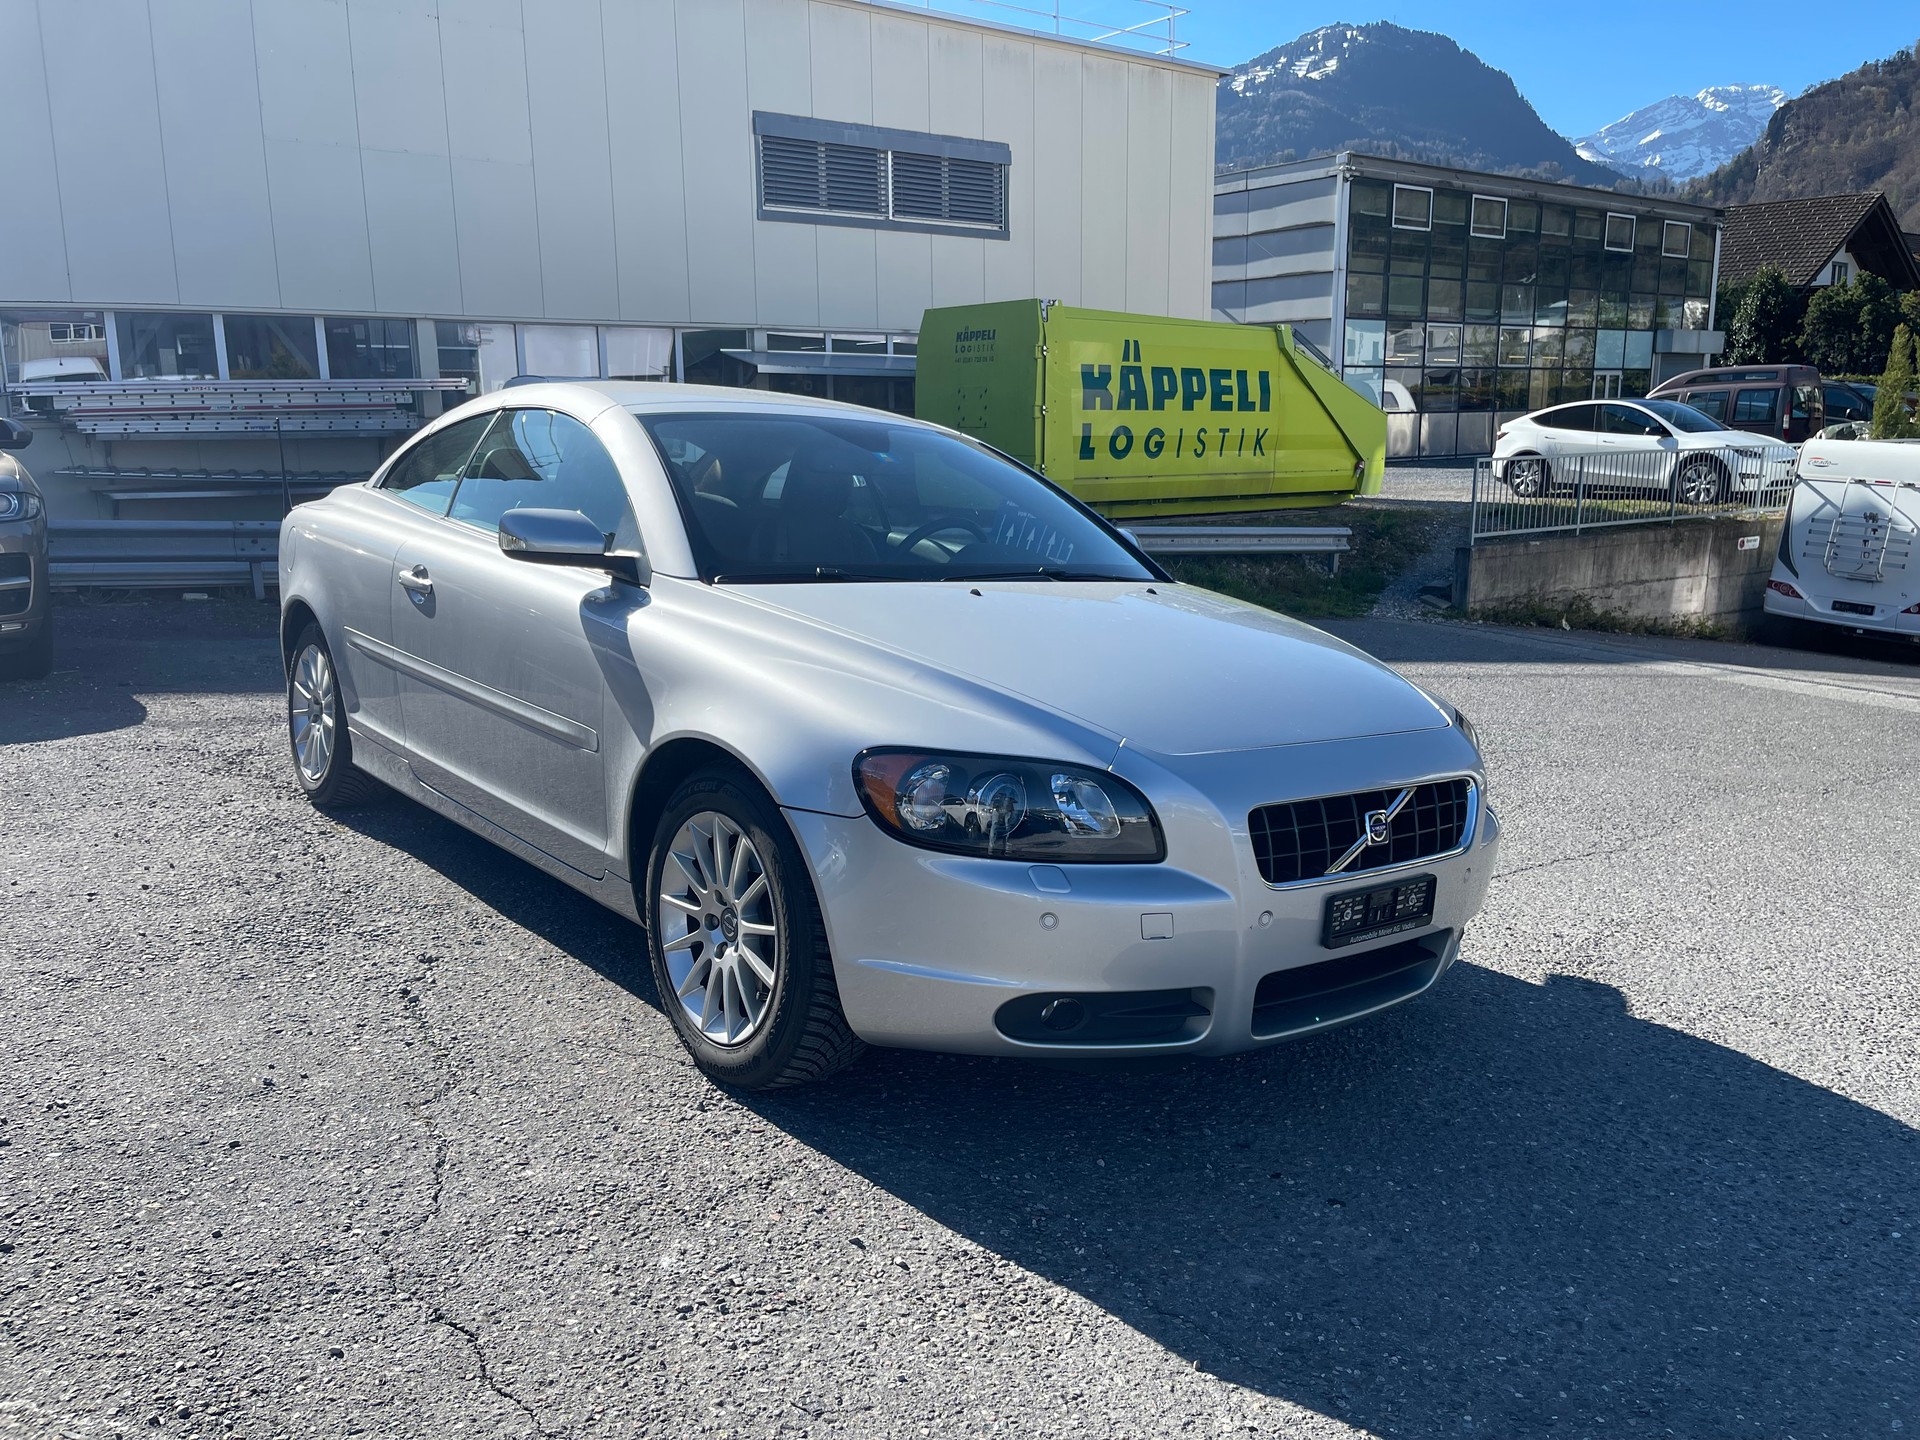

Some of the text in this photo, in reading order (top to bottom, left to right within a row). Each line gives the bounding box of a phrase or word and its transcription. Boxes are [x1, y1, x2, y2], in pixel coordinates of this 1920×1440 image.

[956, 325, 996, 342] KÄPPELI
[955, 345, 995, 353] LOGISTIK
[1080, 340, 1271, 413] KÄPPELI
[1079, 422, 1270, 460] LOGISTIK
[1350, 931, 1378, 944] Automobile
[1378, 927, 1392, 937] Meier
[1392, 924, 1401, 933] AG
